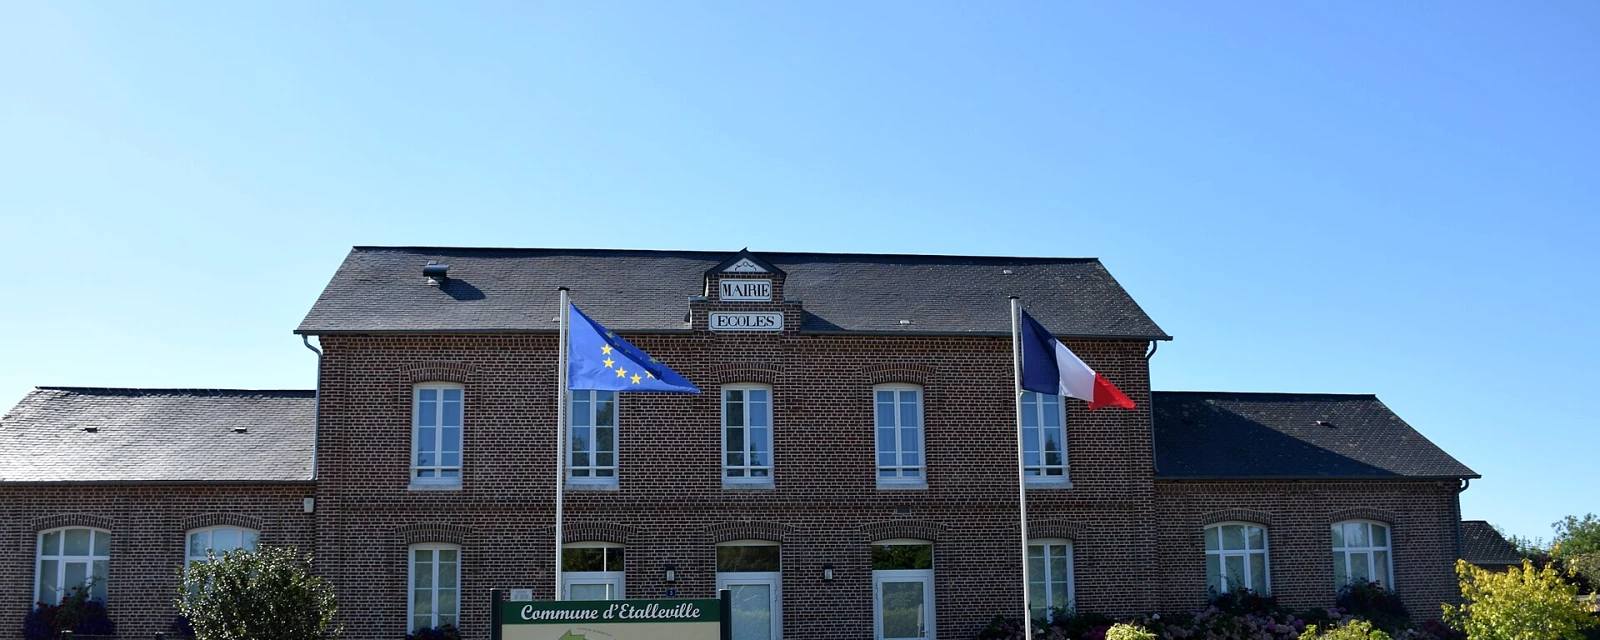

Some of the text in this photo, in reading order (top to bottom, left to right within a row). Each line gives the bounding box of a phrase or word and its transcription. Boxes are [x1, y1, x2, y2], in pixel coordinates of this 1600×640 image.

[722, 283, 770, 297] MAIRIE
[717, 315, 775, 327] ECOLES
[520, 604, 599, 620] Commune
